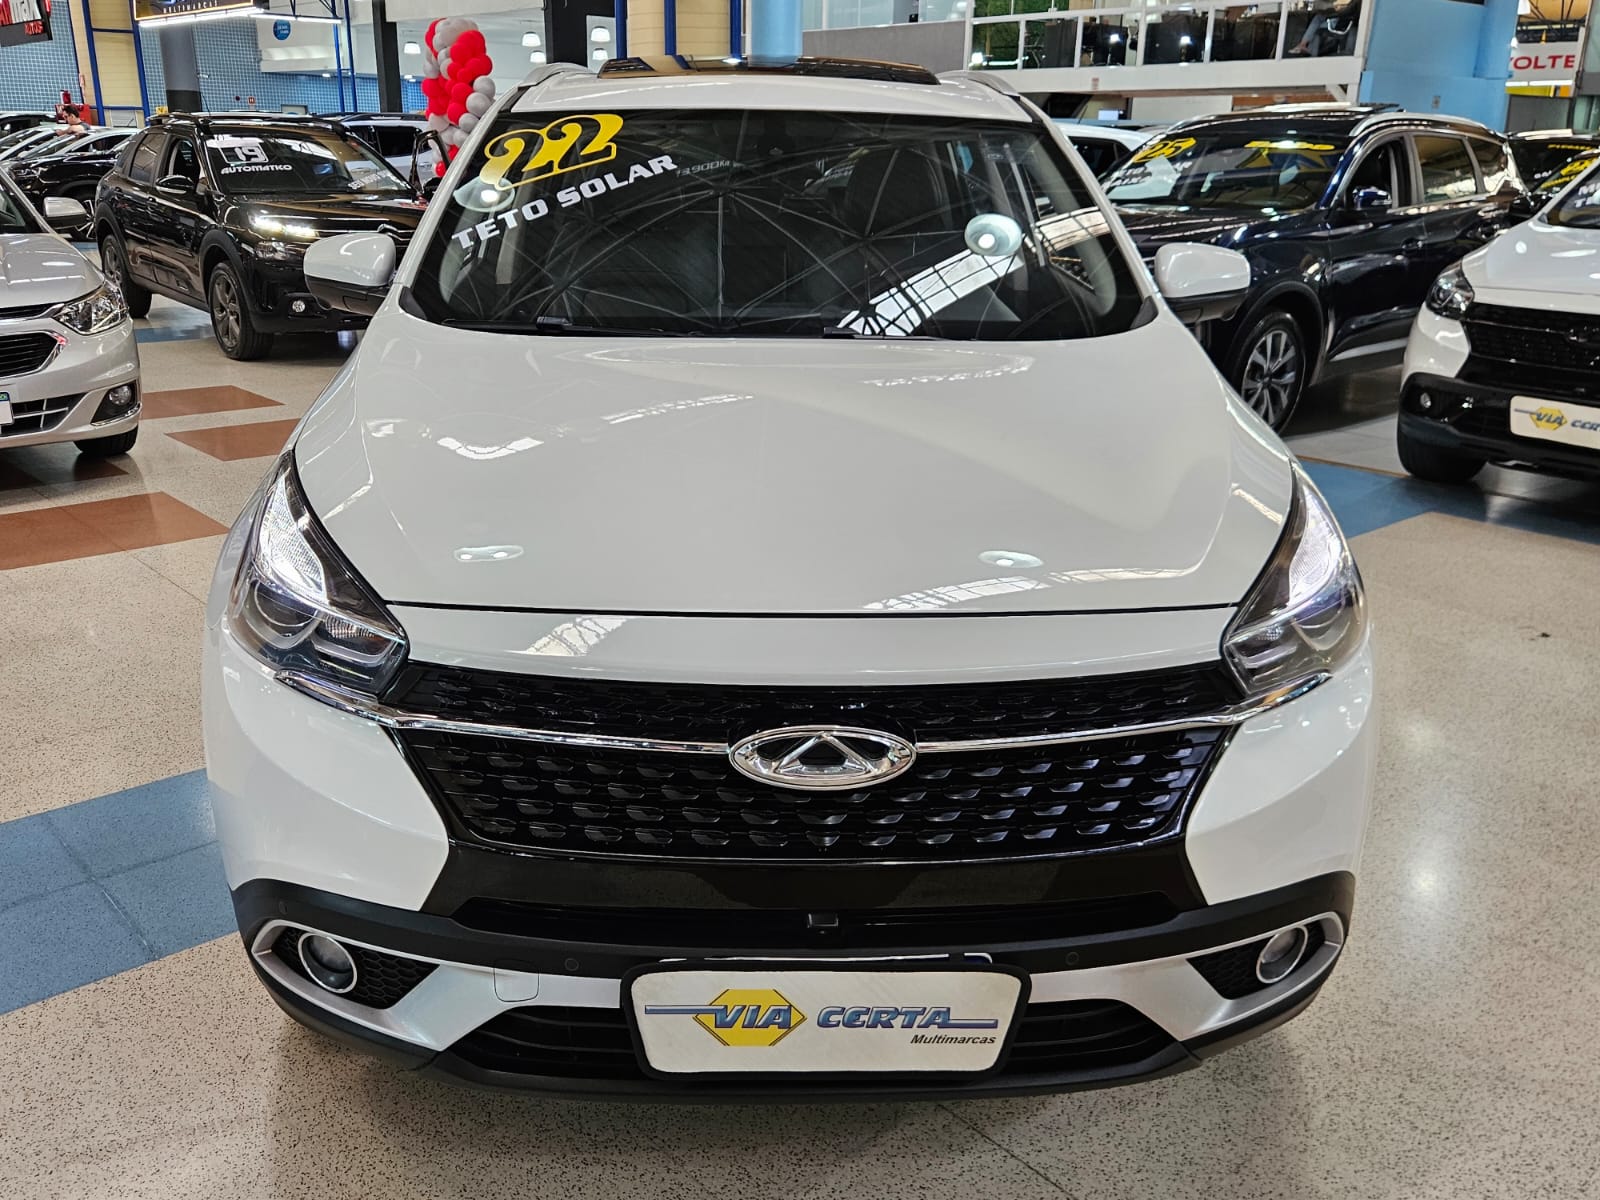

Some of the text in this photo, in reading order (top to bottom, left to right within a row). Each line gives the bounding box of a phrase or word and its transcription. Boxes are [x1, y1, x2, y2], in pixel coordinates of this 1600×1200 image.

[478, 113, 624, 191] 22
[451, 155, 677, 249] TETO SOLAR
[711, 1005, 953, 1029] VIA CERTA
[910, 1033, 997, 1045] Multimarcas
